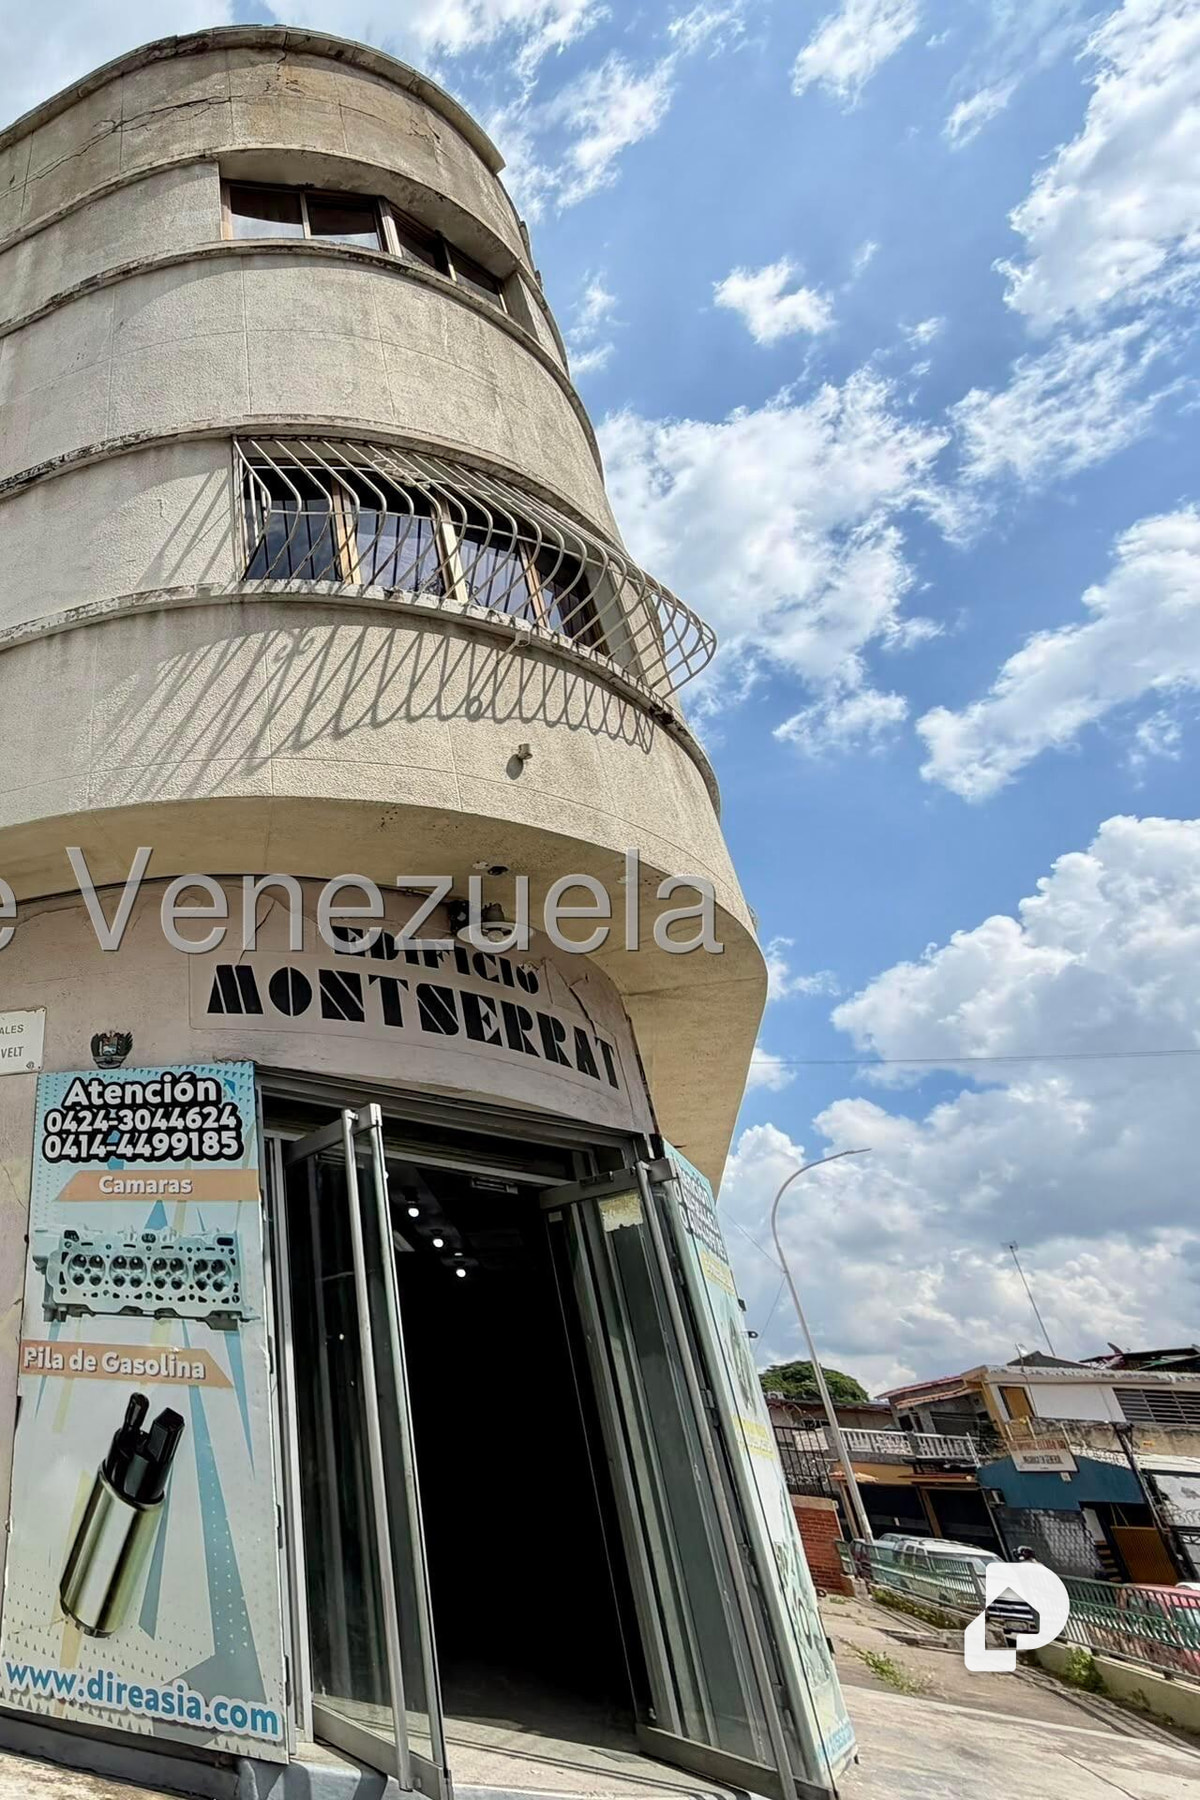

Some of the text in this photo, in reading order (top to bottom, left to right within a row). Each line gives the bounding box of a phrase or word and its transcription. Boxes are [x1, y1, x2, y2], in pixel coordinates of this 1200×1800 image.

[333, 926, 540, 995] EDIFICIO
[206, 964, 620, 1090] MONTSERRAT
[64, 1074, 218, 1107] Atención
[47, 1105, 237, 1133] 0424-3044624
[44, 1130, 239, 1159] 0414-4499185
[98, 1175, 193, 1195] Camaras
[24, 1346, 206, 1379] Pila de Gasolina
[5, 1661, 279, 1736] www.direasia.com
